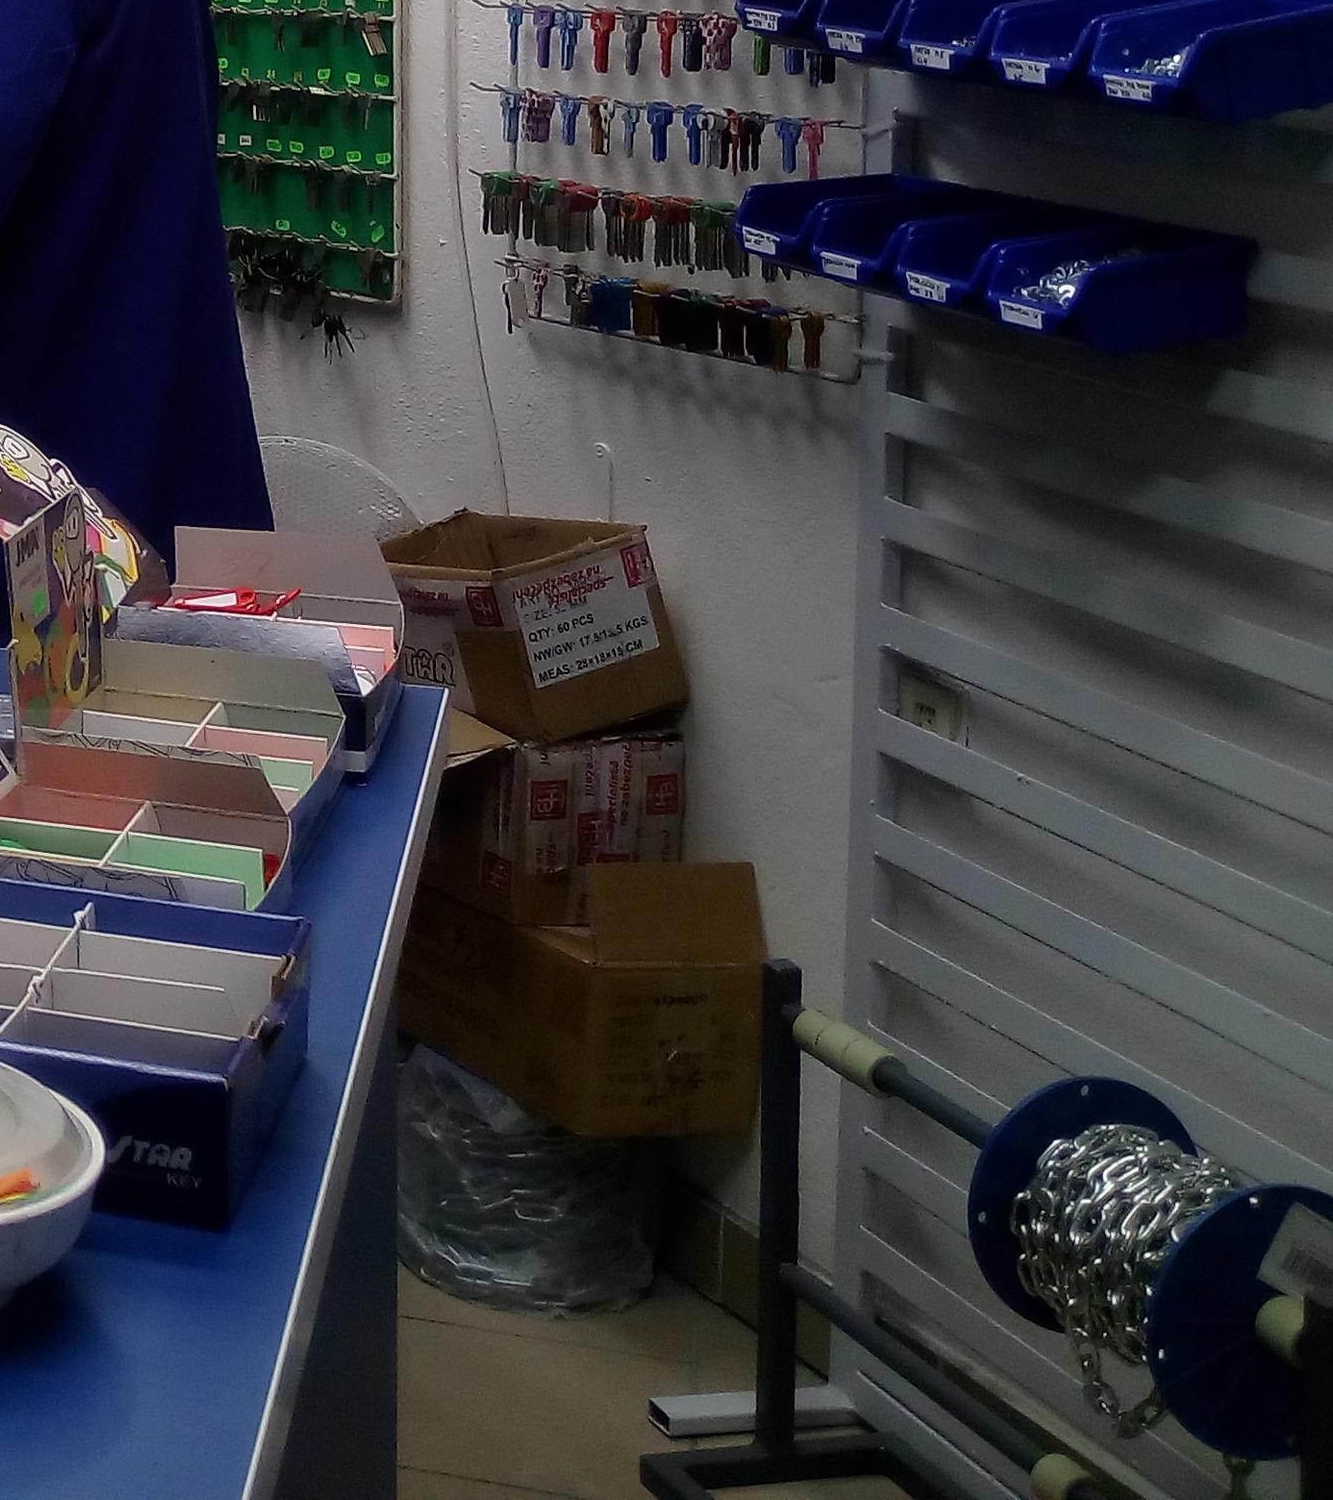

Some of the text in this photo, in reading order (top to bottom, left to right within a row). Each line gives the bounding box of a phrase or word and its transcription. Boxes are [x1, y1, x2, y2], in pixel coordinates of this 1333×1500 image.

[16, 527, 41, 567] JMA
[528, 627, 555, 643] QTY:
[572, 613, 595, 628] PCS
[625, 615, 650, 632] KGS
[405, 645, 455, 687] TAR
[538, 663, 574, 684] MEAS:
[106, 1135, 195, 1170] STAR
[167, 1173, 203, 1189] KEY
